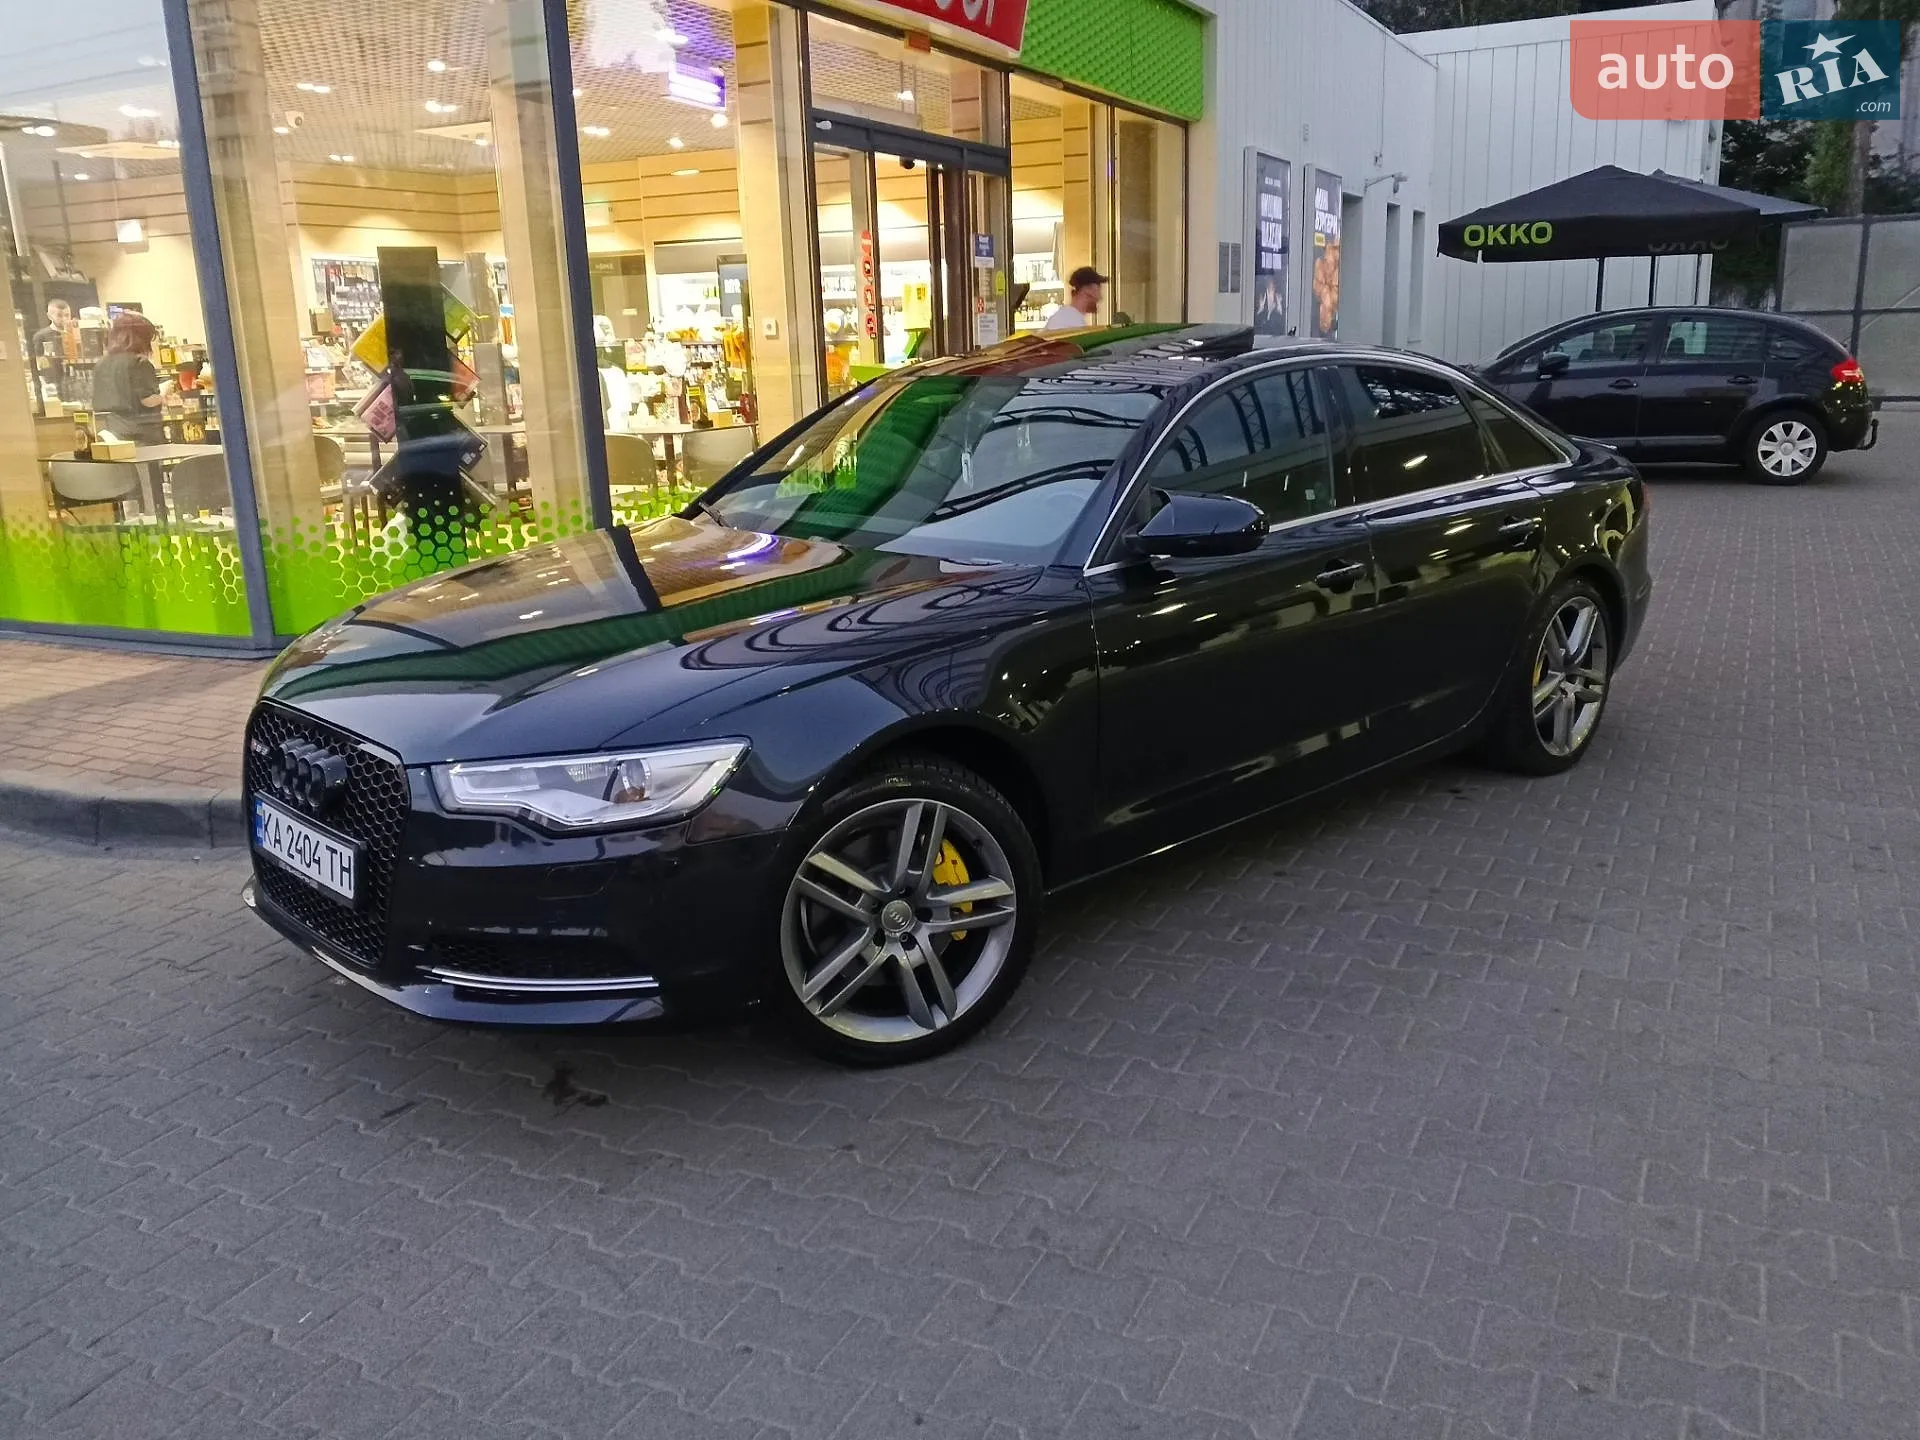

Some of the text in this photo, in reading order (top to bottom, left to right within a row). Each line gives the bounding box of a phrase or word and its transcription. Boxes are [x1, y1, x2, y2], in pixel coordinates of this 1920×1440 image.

[1463, 220, 1554, 248] OKKO
[263, 812, 283, 852] KA
[287, 824, 321, 875] 2404
[325, 846, 352, 891] TH
